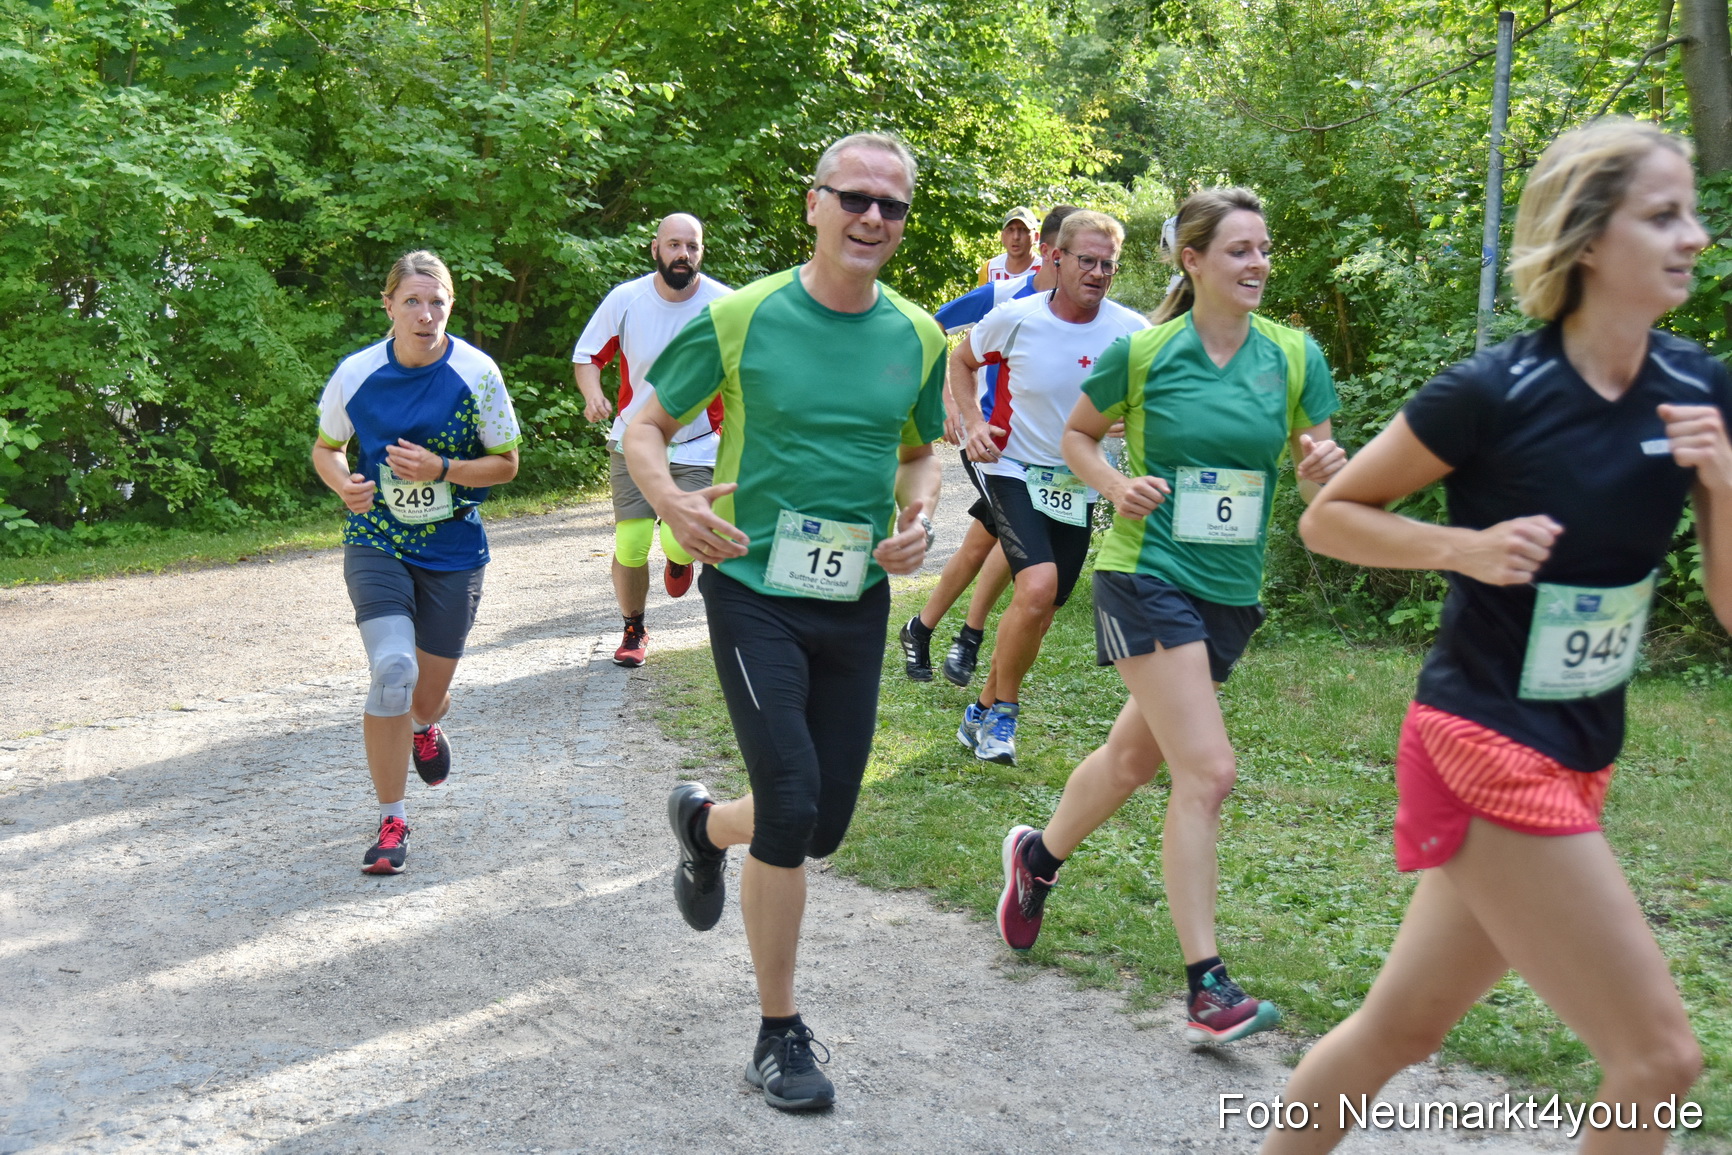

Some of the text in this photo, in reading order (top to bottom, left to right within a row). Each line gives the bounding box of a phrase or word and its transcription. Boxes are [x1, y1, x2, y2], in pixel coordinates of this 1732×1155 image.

[392, 486, 435, 508] 249
[1038, 488, 1072, 511] 358
[1216, 496, 1233, 523] 6
[807, 547, 844, 578] 15
[788, 571, 818, 583] Suttner
[1563, 622, 1632, 668] 948
